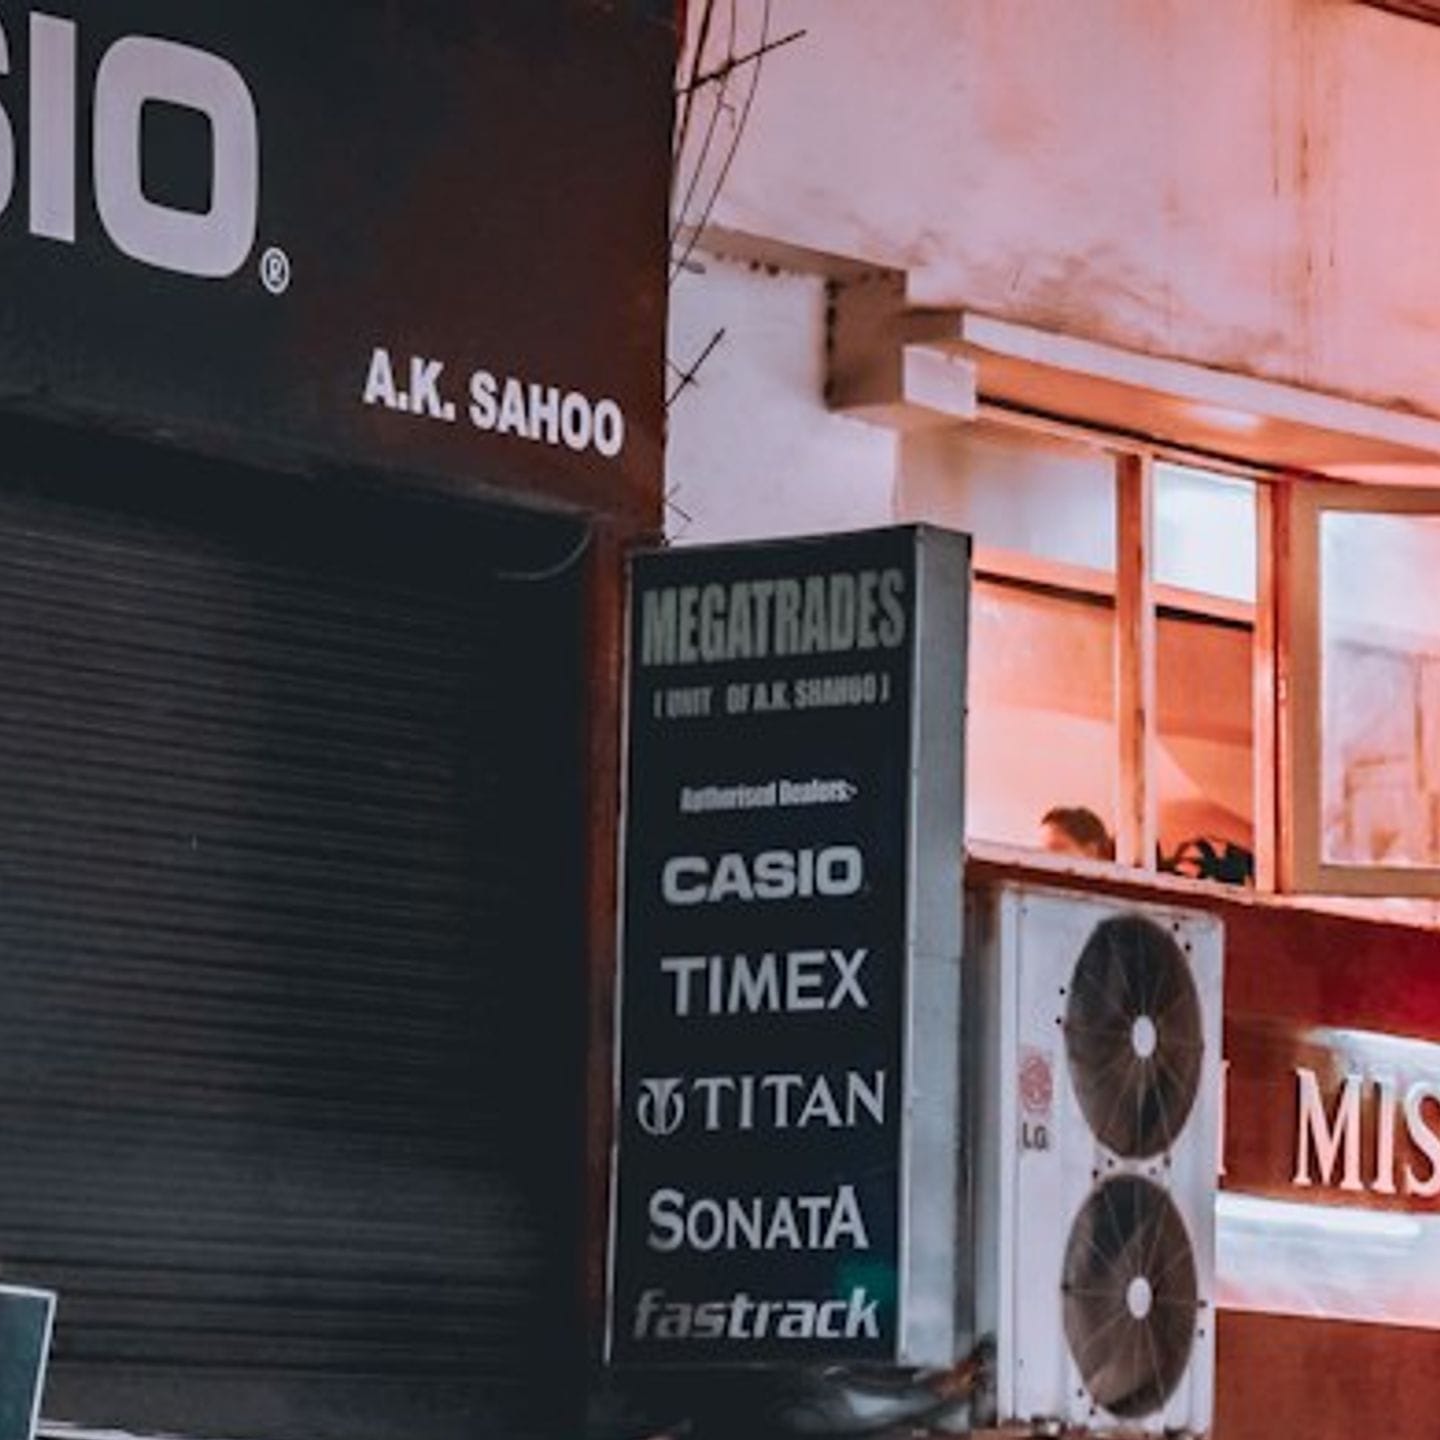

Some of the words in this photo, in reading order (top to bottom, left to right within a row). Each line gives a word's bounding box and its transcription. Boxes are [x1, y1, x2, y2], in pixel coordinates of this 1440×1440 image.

[362, 346, 456, 422] A.K.
[469, 368, 624, 457] SAHOO
[642, 568, 907, 666] MEGATRADES
[662, 846, 862, 904] CASIO
[661, 949, 868, 1016] TIMEX
[693, 1070, 885, 1131] TITAN
[634, 1287, 879, 1339] fastrack
